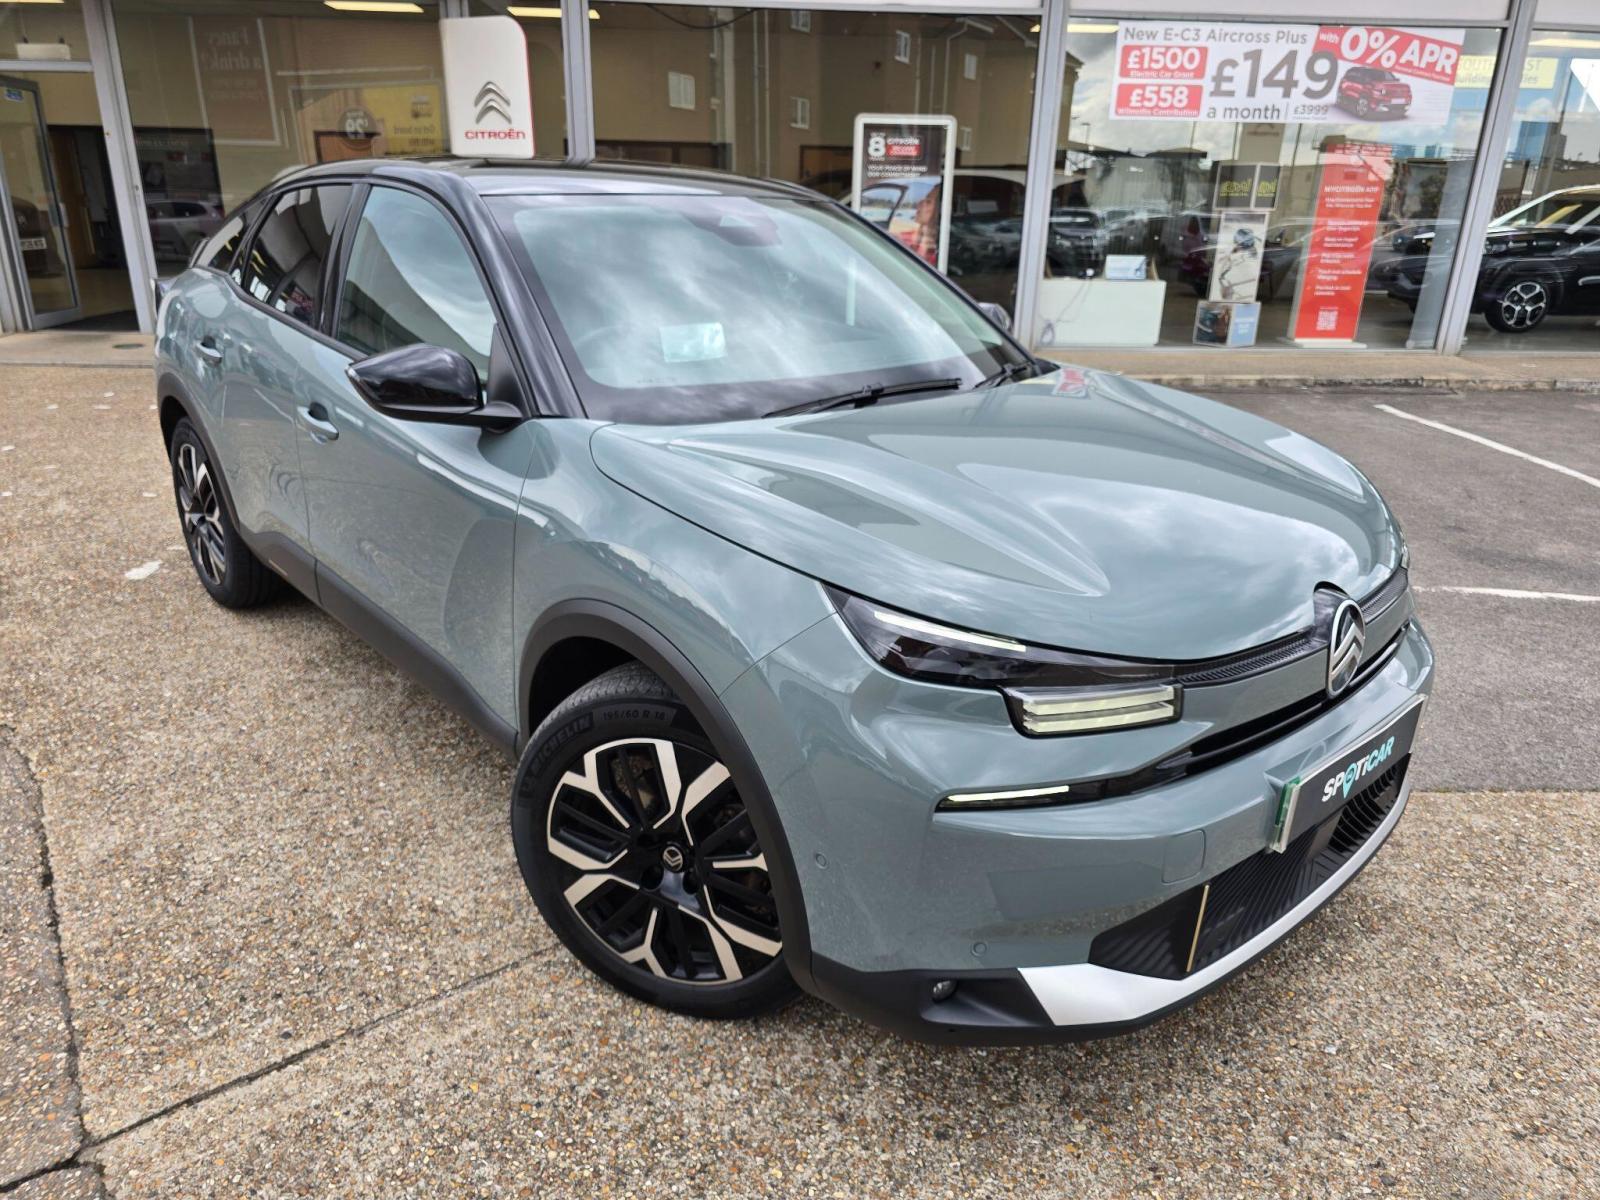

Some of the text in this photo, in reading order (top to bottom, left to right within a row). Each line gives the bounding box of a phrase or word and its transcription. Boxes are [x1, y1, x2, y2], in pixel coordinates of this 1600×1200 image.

[1124, 28, 1308, 44] New E-C3 Aircross Plus
[1127, 46, 1201, 70] £1500
[1319, 26, 1459, 75] with 0% APR
[1209, 49, 1339, 100] £149
[1130, 86, 1189, 108] £558
[1206, 106, 1217, 119] a
[1223, 104, 1281, 120] month
[1293, 103, 1329, 116] £3999
[868, 137, 886, 157] 8
[603, 709, 638, 721] 195/60
[643, 709, 650, 719] R
